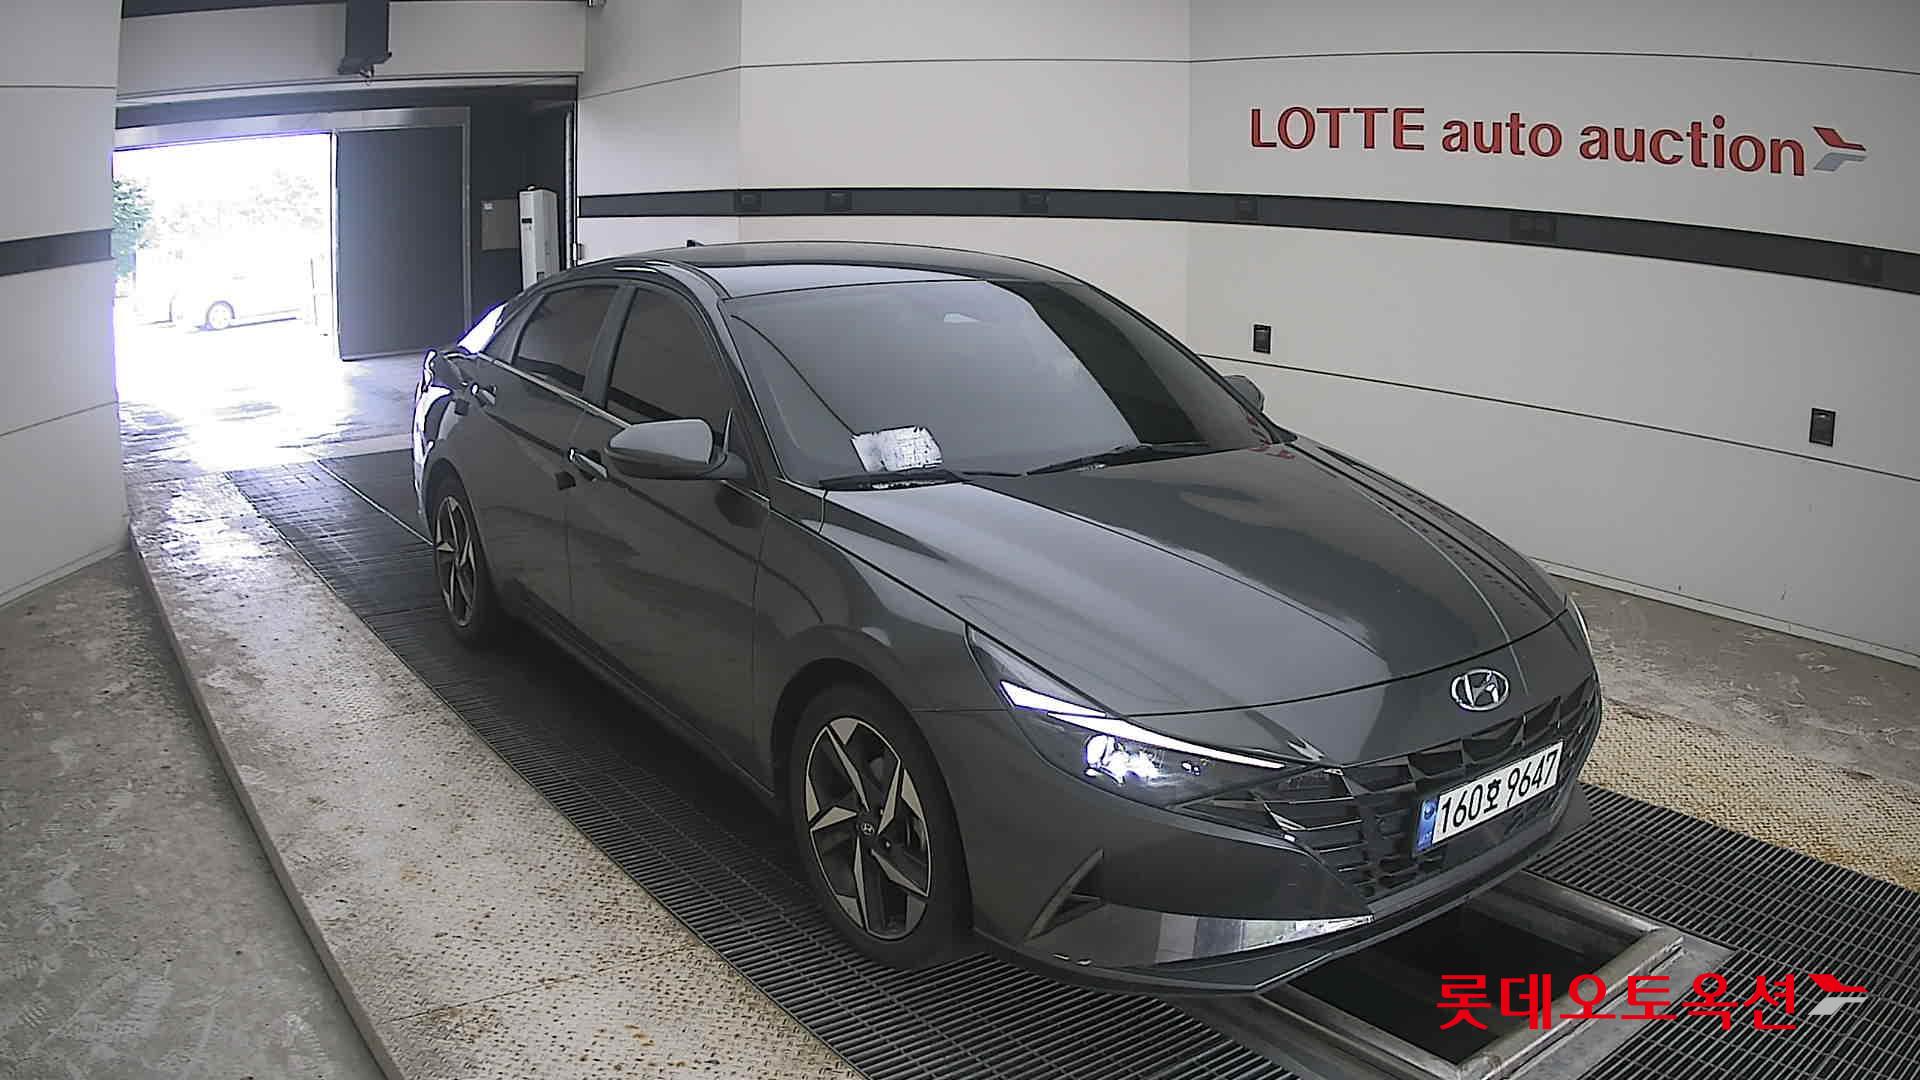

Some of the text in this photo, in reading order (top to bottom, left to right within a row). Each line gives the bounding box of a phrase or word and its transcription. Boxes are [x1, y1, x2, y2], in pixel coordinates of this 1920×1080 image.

[1249, 106, 1806, 176] LOTTE auto auction
[1441, 749, 1559, 834] 160호 9647
